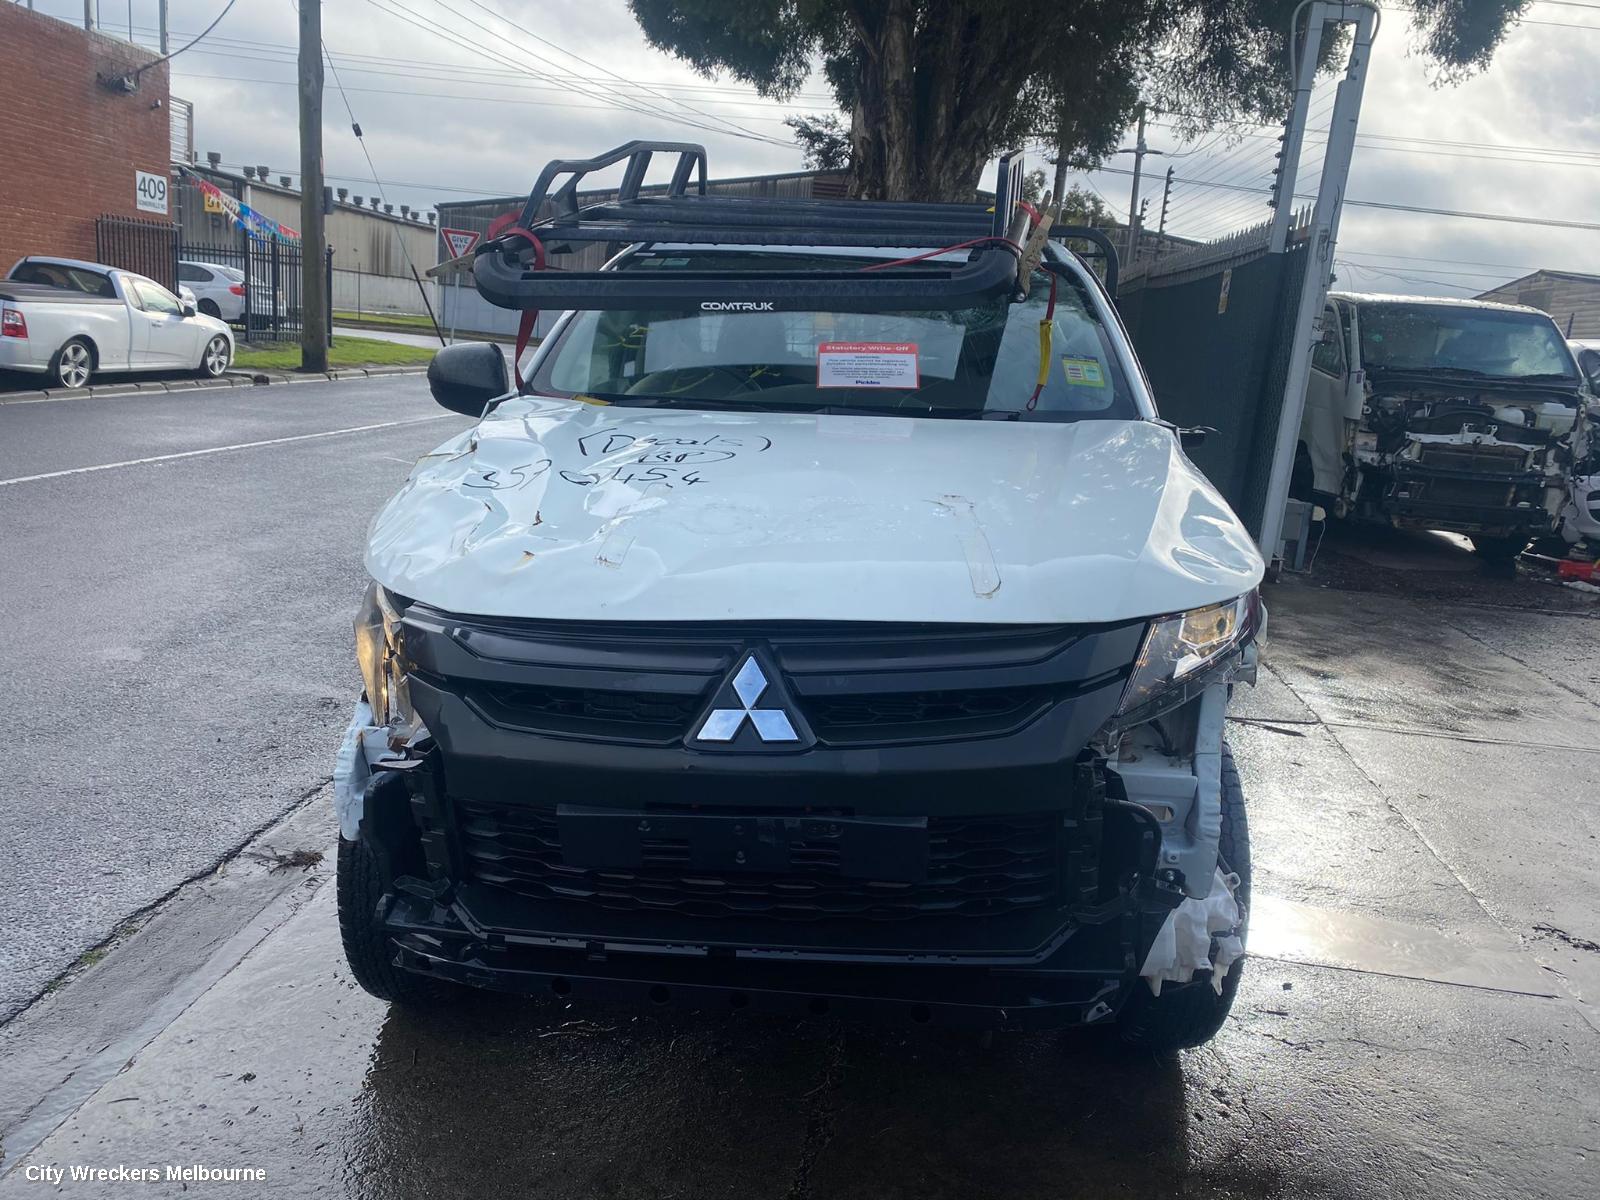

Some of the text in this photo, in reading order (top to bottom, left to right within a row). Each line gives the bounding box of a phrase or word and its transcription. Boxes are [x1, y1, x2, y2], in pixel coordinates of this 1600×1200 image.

[138, 176, 165, 200] 409
[452, 235, 469, 243] GIVE
[700, 302, 774, 311] COMTRUK
[826, 345, 866, 353] Statutory
